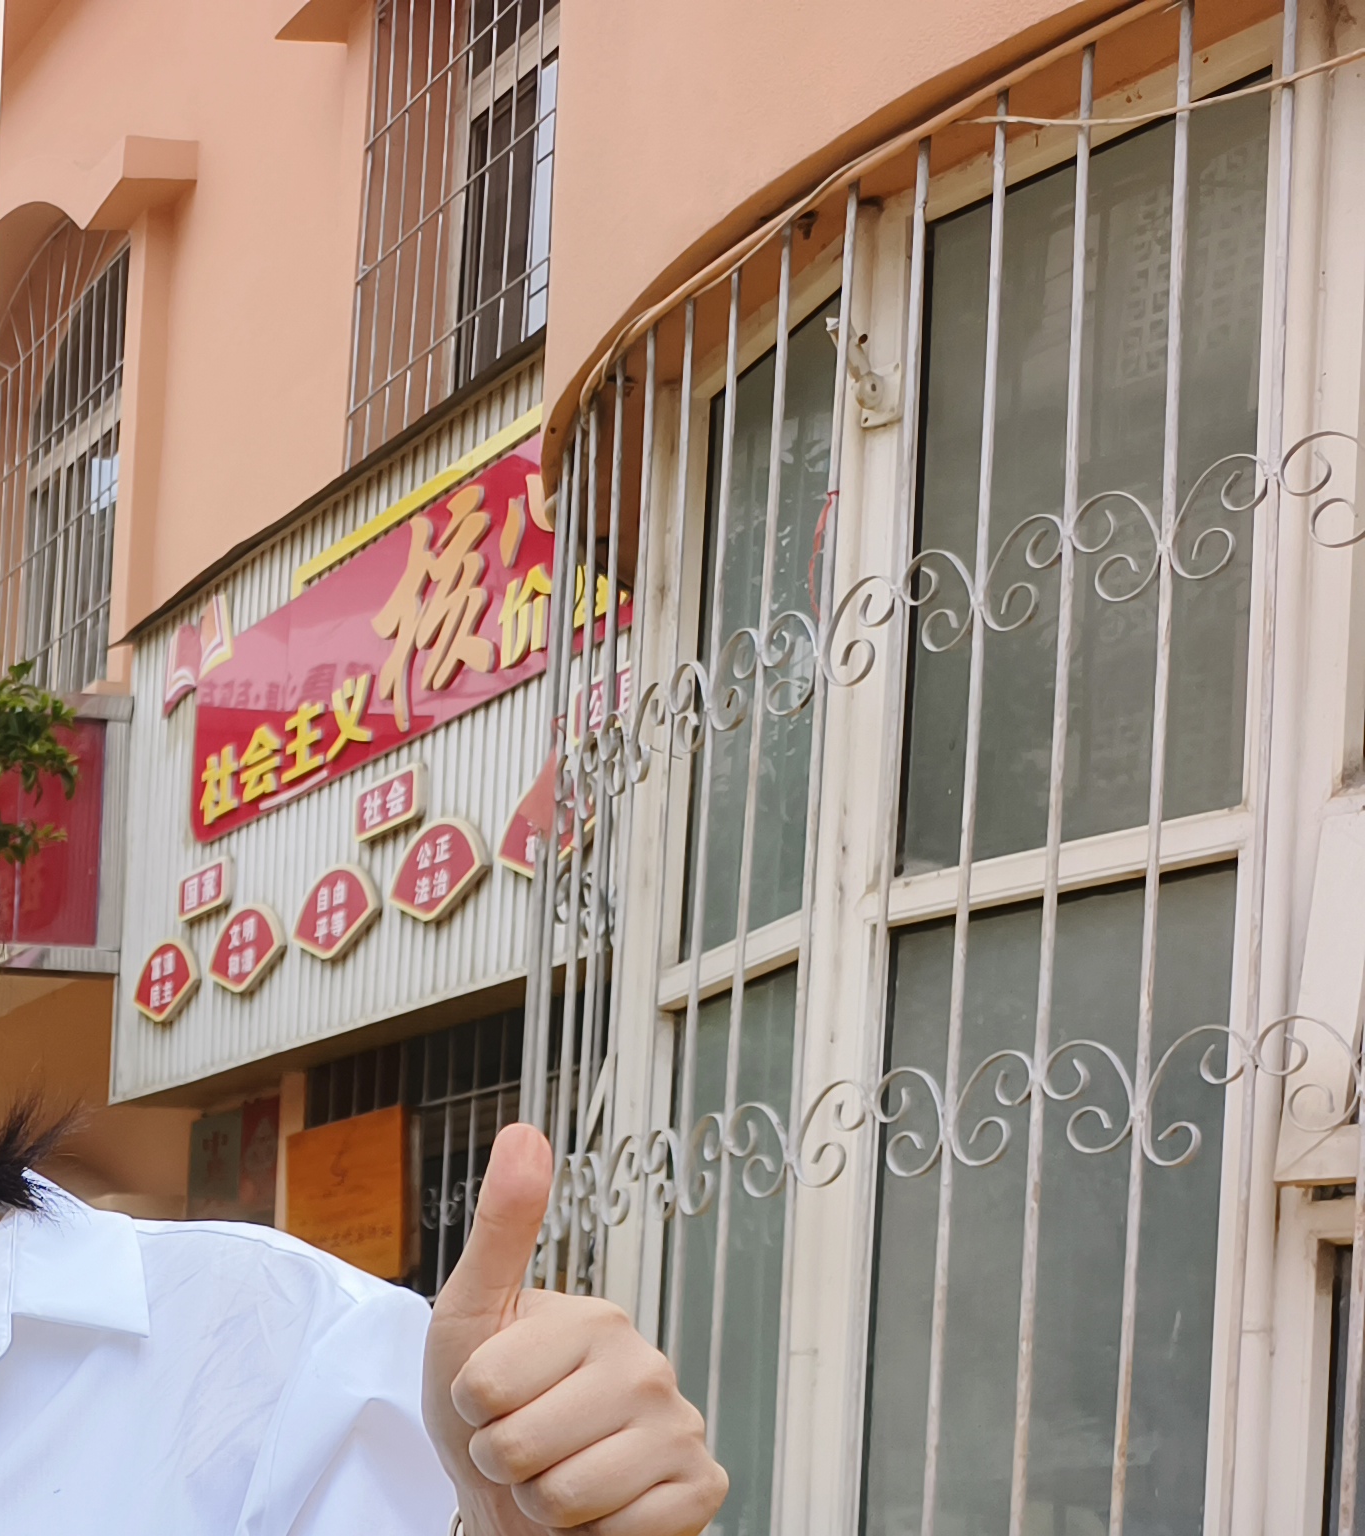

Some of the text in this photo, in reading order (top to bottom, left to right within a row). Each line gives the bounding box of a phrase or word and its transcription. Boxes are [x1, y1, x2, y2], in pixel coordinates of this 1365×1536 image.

[363, 780, 407, 829] 社会
[417, 832, 453, 870] 公正
[183, 868, 221, 913] 国家
[317, 879, 348, 913] 自由
[414, 868, 451, 905] 法治
[228, 916, 258, 950] 文明
[315, 909, 347, 944] 平等
